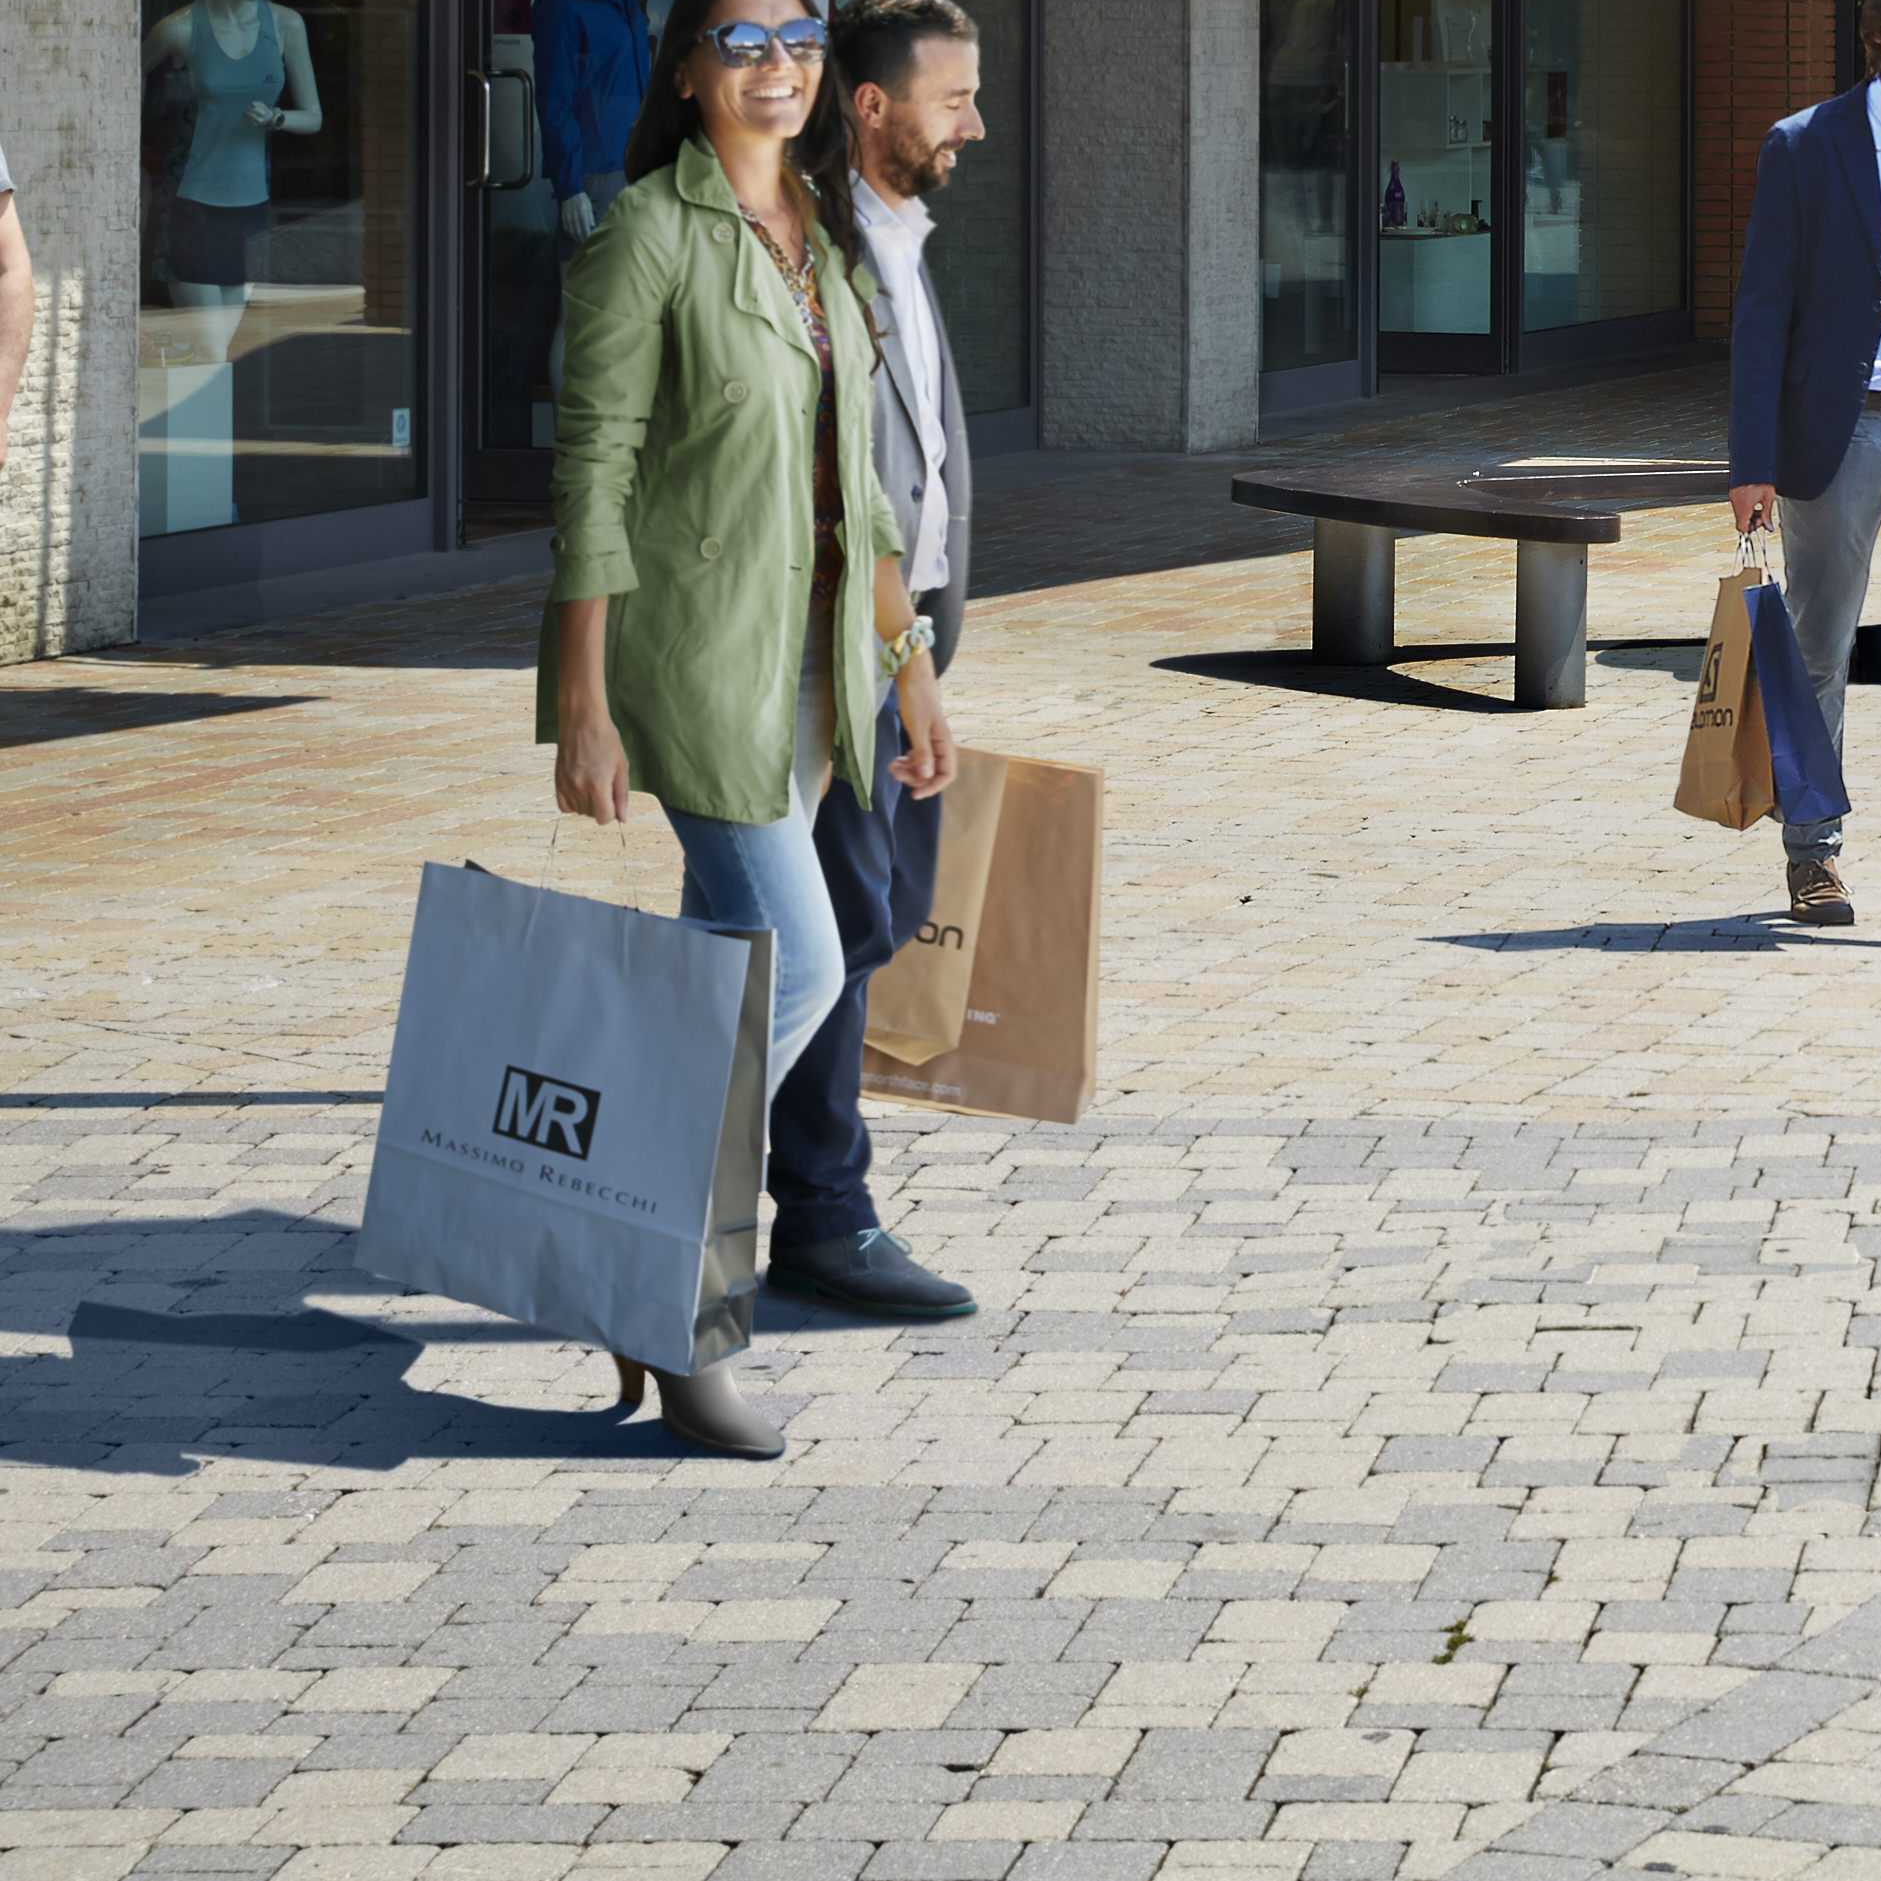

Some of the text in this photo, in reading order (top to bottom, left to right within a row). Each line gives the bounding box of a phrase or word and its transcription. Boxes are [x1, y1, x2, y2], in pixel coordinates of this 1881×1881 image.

[496, 1069, 592, 1157] MR
[420, 1128, 658, 1214] MASSIMO REBECCHI
